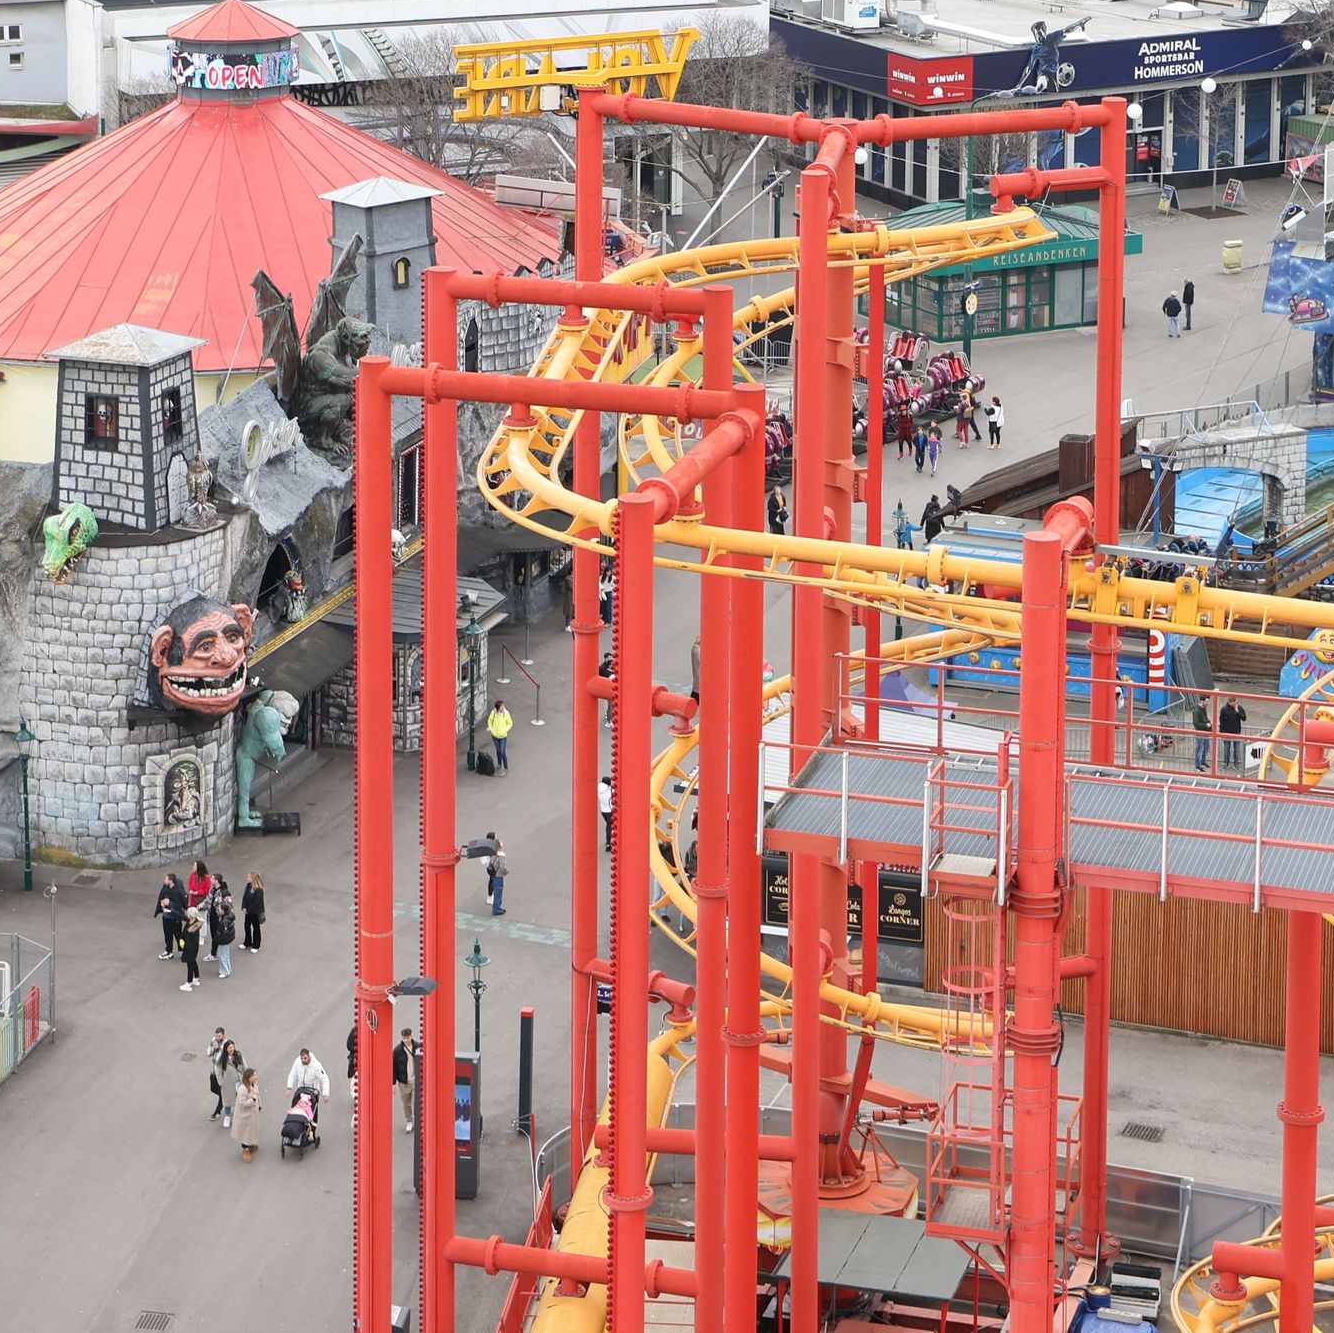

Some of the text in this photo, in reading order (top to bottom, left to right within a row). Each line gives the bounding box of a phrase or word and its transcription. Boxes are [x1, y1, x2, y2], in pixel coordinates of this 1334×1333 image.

[1138, 37, 1201, 56] ADMIRAL
[1143, 52, 1195, 64] SPORTSBAR
[208, 65, 265, 88] OPEN
[1134, 60, 1204, 79] HOMMERSON
[993, 246, 1087, 267] REISEANDENKEN
[880, 914, 920, 926] CORNER
[888, 904, 912, 917] Langos
